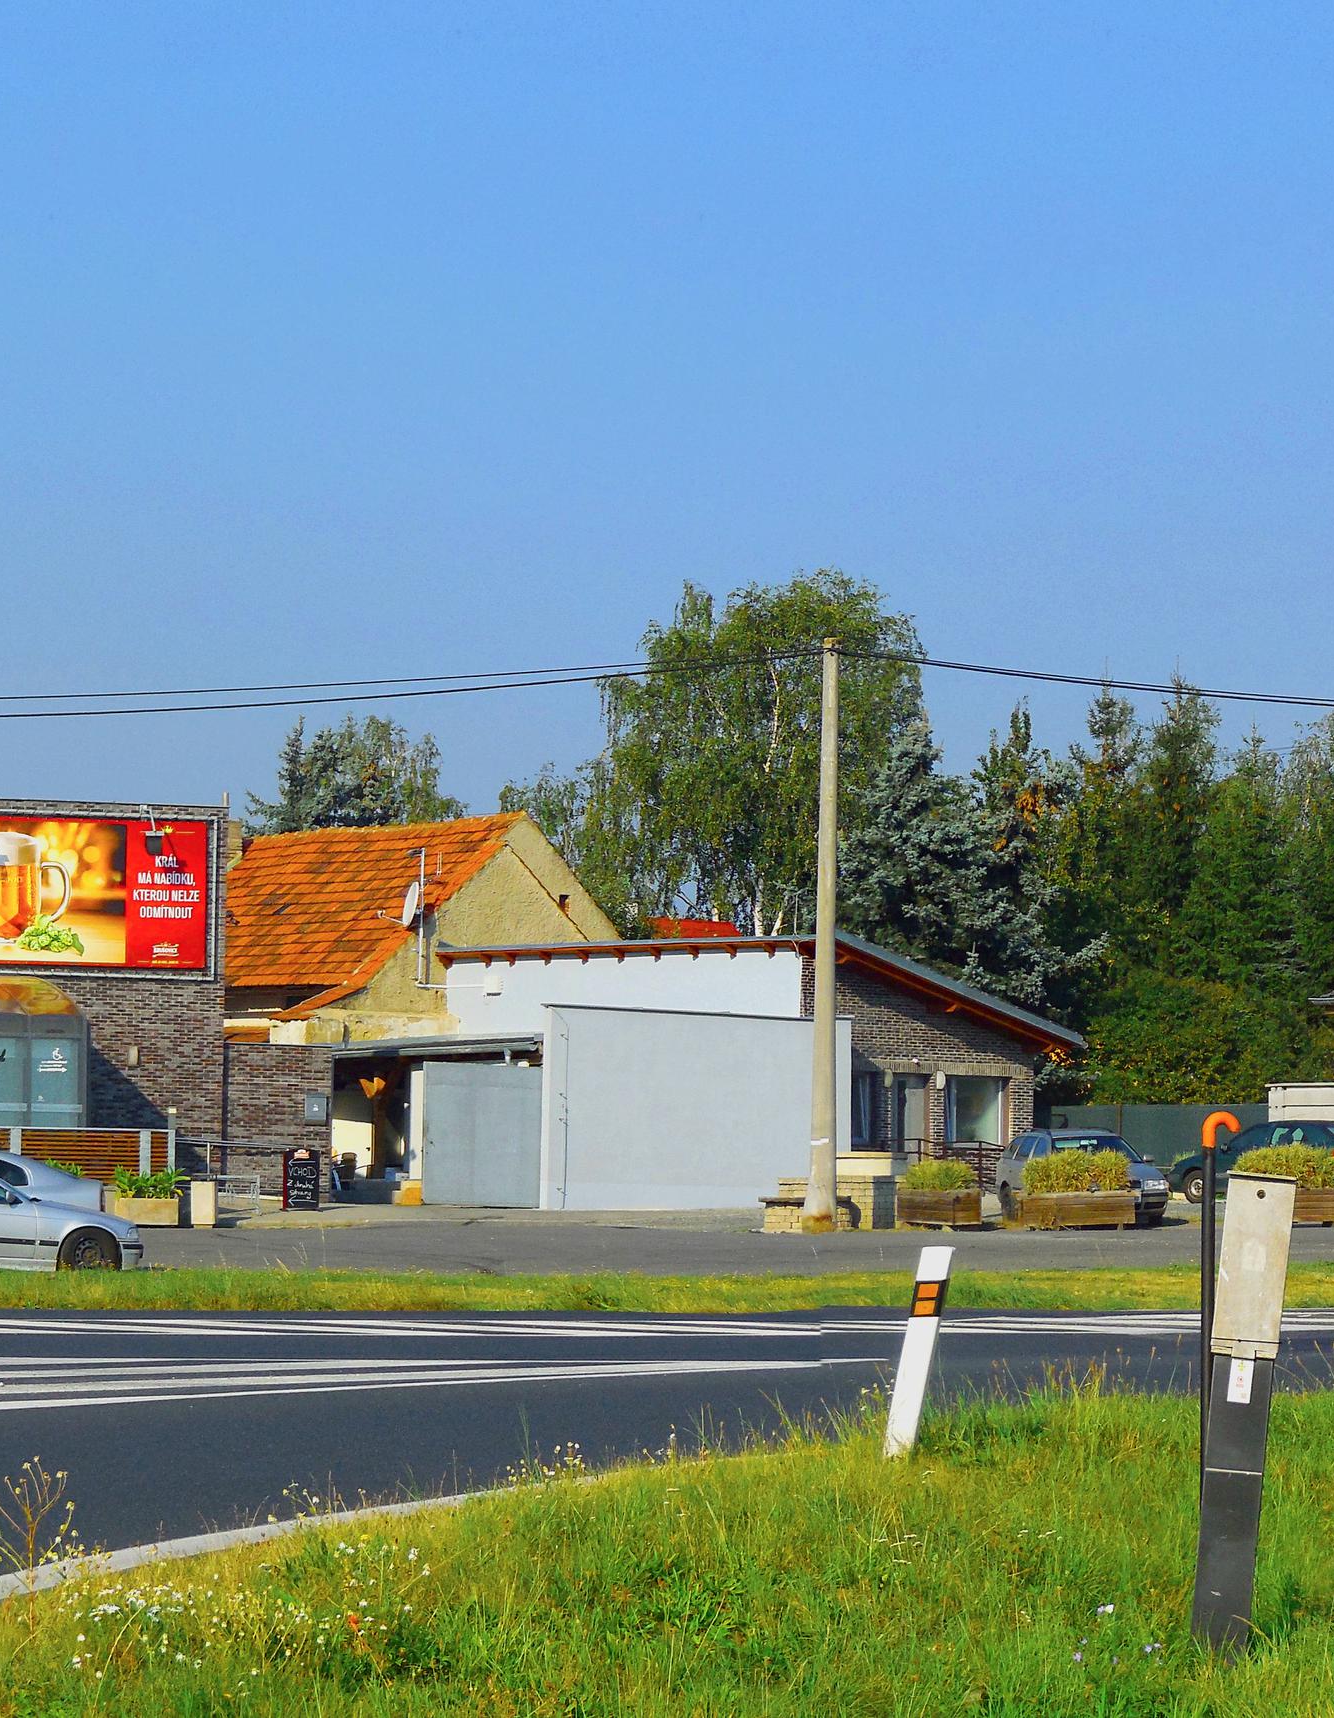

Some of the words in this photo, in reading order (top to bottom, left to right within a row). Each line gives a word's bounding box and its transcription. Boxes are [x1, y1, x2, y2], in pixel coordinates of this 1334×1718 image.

[155, 854, 179, 868] KRÁL
[138, 870, 152, 884] MÁ
[154, 870, 196, 887] NABÍDKU,
[133, 889, 169, 902] KTEROU
[171, 890, 200, 902] NELZE
[139, 904, 193, 919] ODMÍTNOUT
